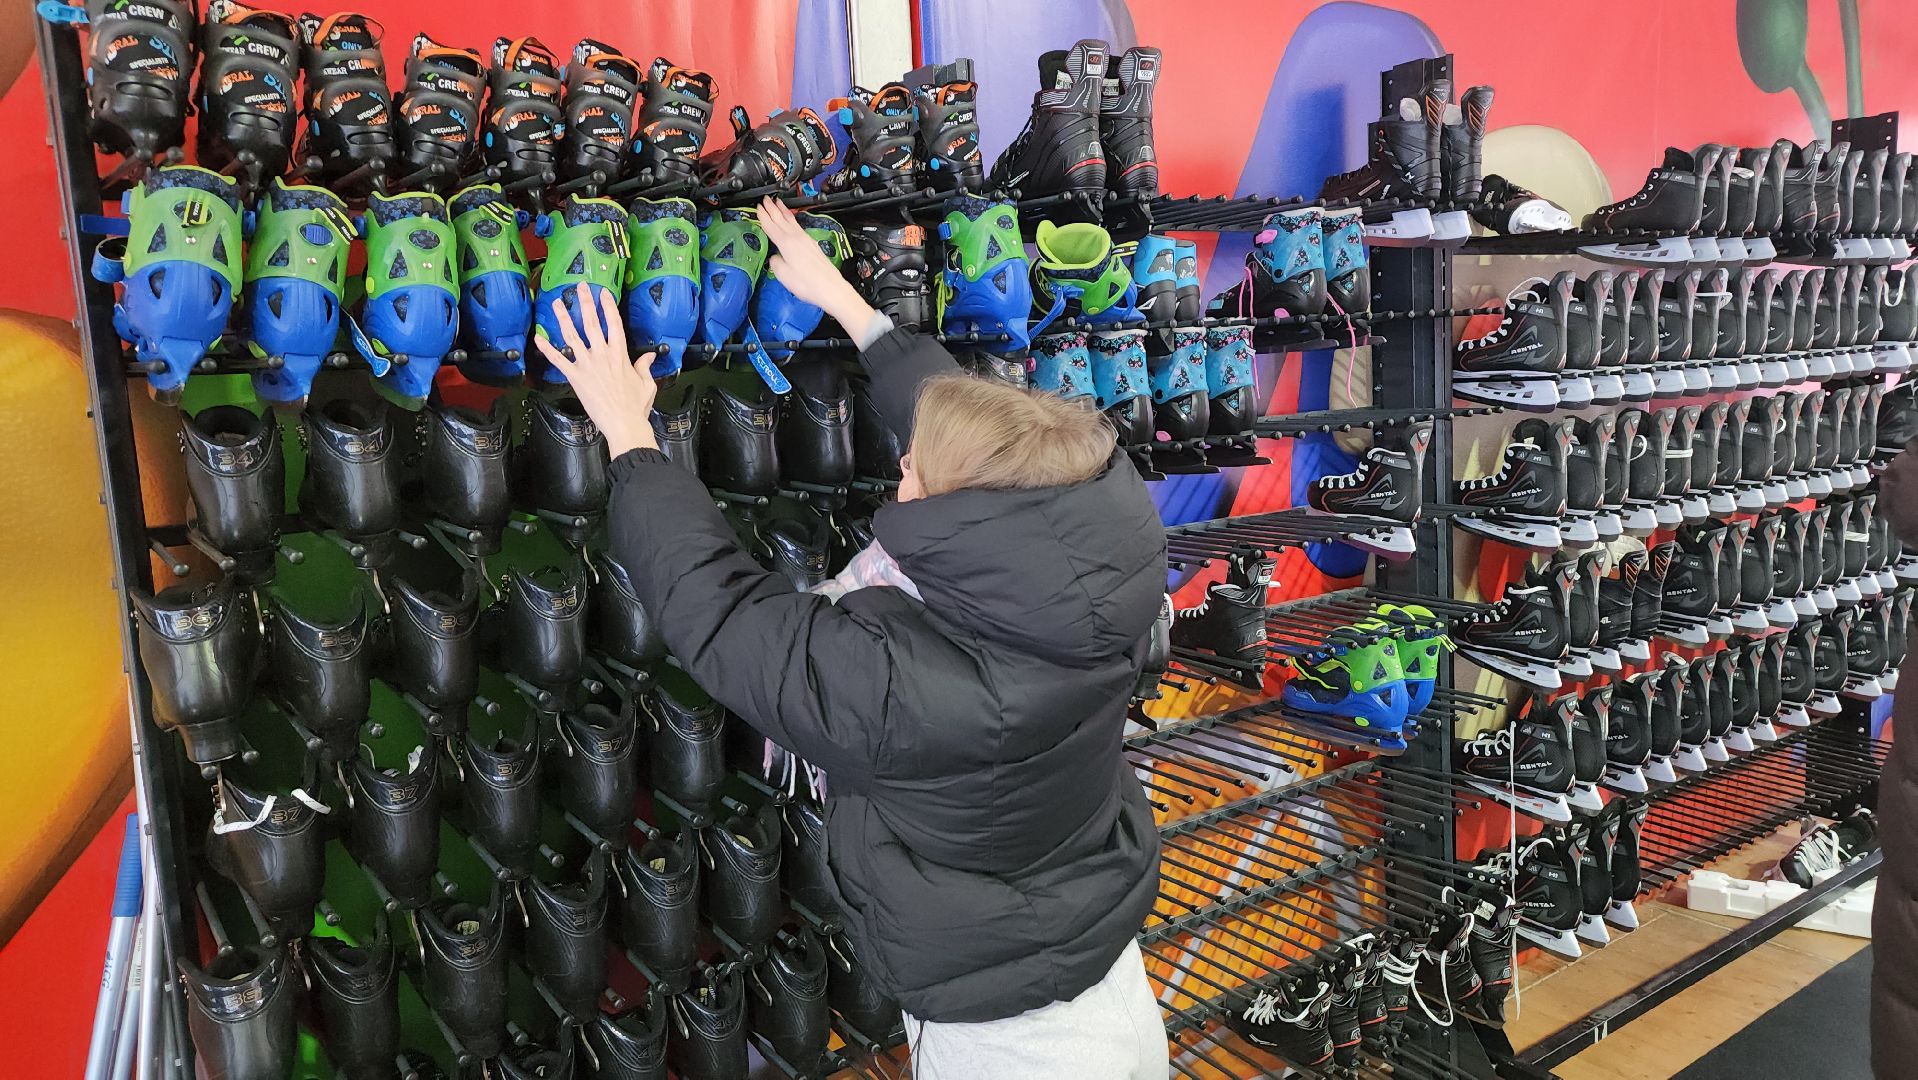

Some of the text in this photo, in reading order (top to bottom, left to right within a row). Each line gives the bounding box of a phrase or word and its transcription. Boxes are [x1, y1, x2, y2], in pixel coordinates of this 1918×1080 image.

[129, 4, 165, 20] CREW
[247, 42, 280, 59] CREW
[603, 83, 627, 100] CREW
[681, 104, 702, 118] CREW
[1510, 341, 1544, 355] RENTAL
[347, 441, 380, 455] 34
[475, 435, 502, 449] 34
[1370, 489, 1398, 499] RENTAL
[1511, 487, 1543, 498] RENTAL
[1666, 586, 1698, 597] RENTAL
[1514, 628, 1547, 637] RENTAL
[596, 736, 622, 752] 37
[497, 761, 522, 776] 37
[1519, 760, 1553, 770] RENTAL
[388, 784, 420, 802] 37
[270, 805, 304, 824] 37
